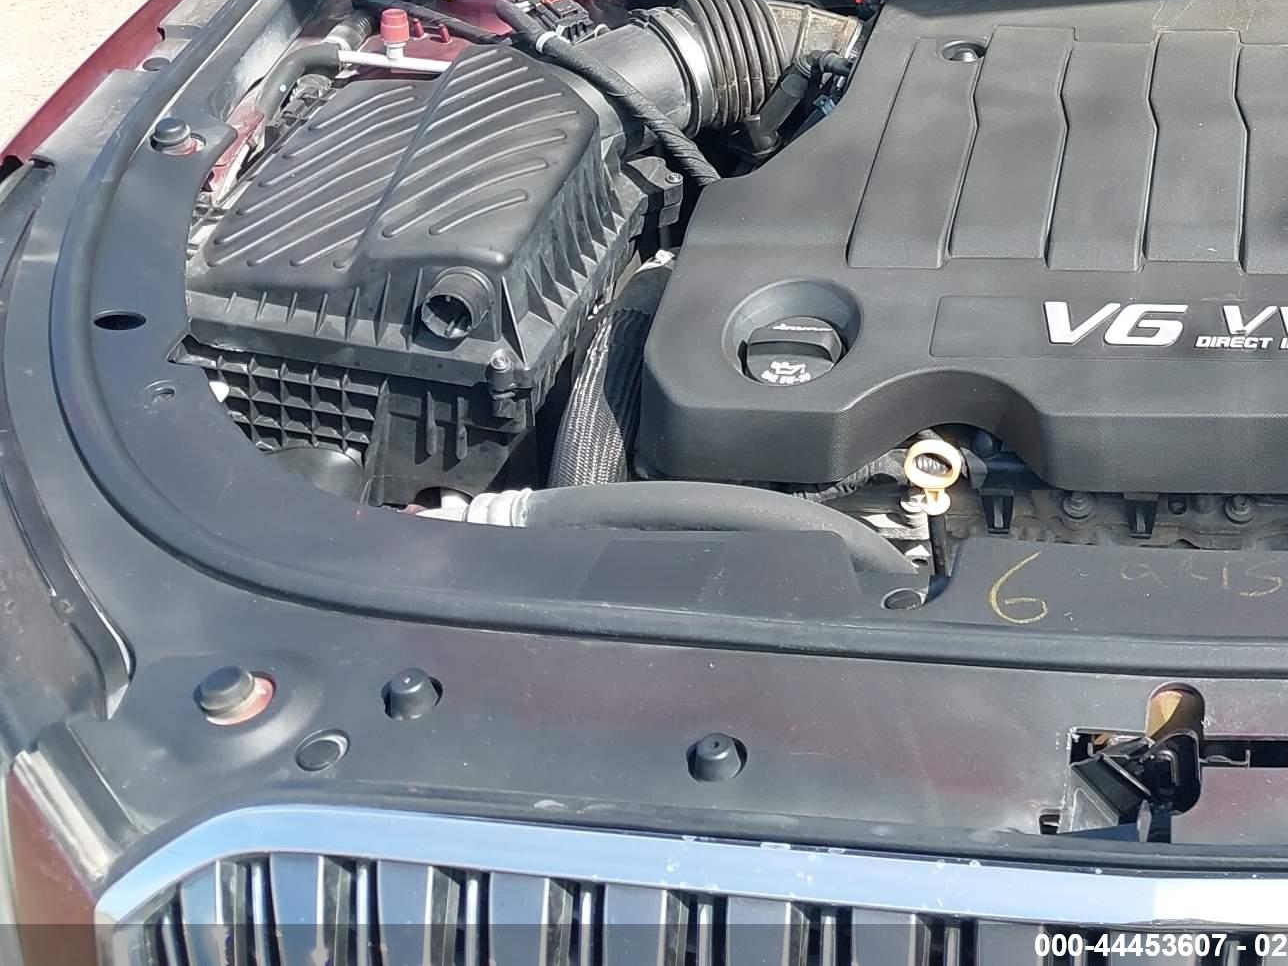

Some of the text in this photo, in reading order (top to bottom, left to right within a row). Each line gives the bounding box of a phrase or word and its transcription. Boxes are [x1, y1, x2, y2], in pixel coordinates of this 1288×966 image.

[1043, 301, 1190, 347] V6
[1194, 334, 1273, 351] DIRECT
[988, 550, 1048, 625] 6
